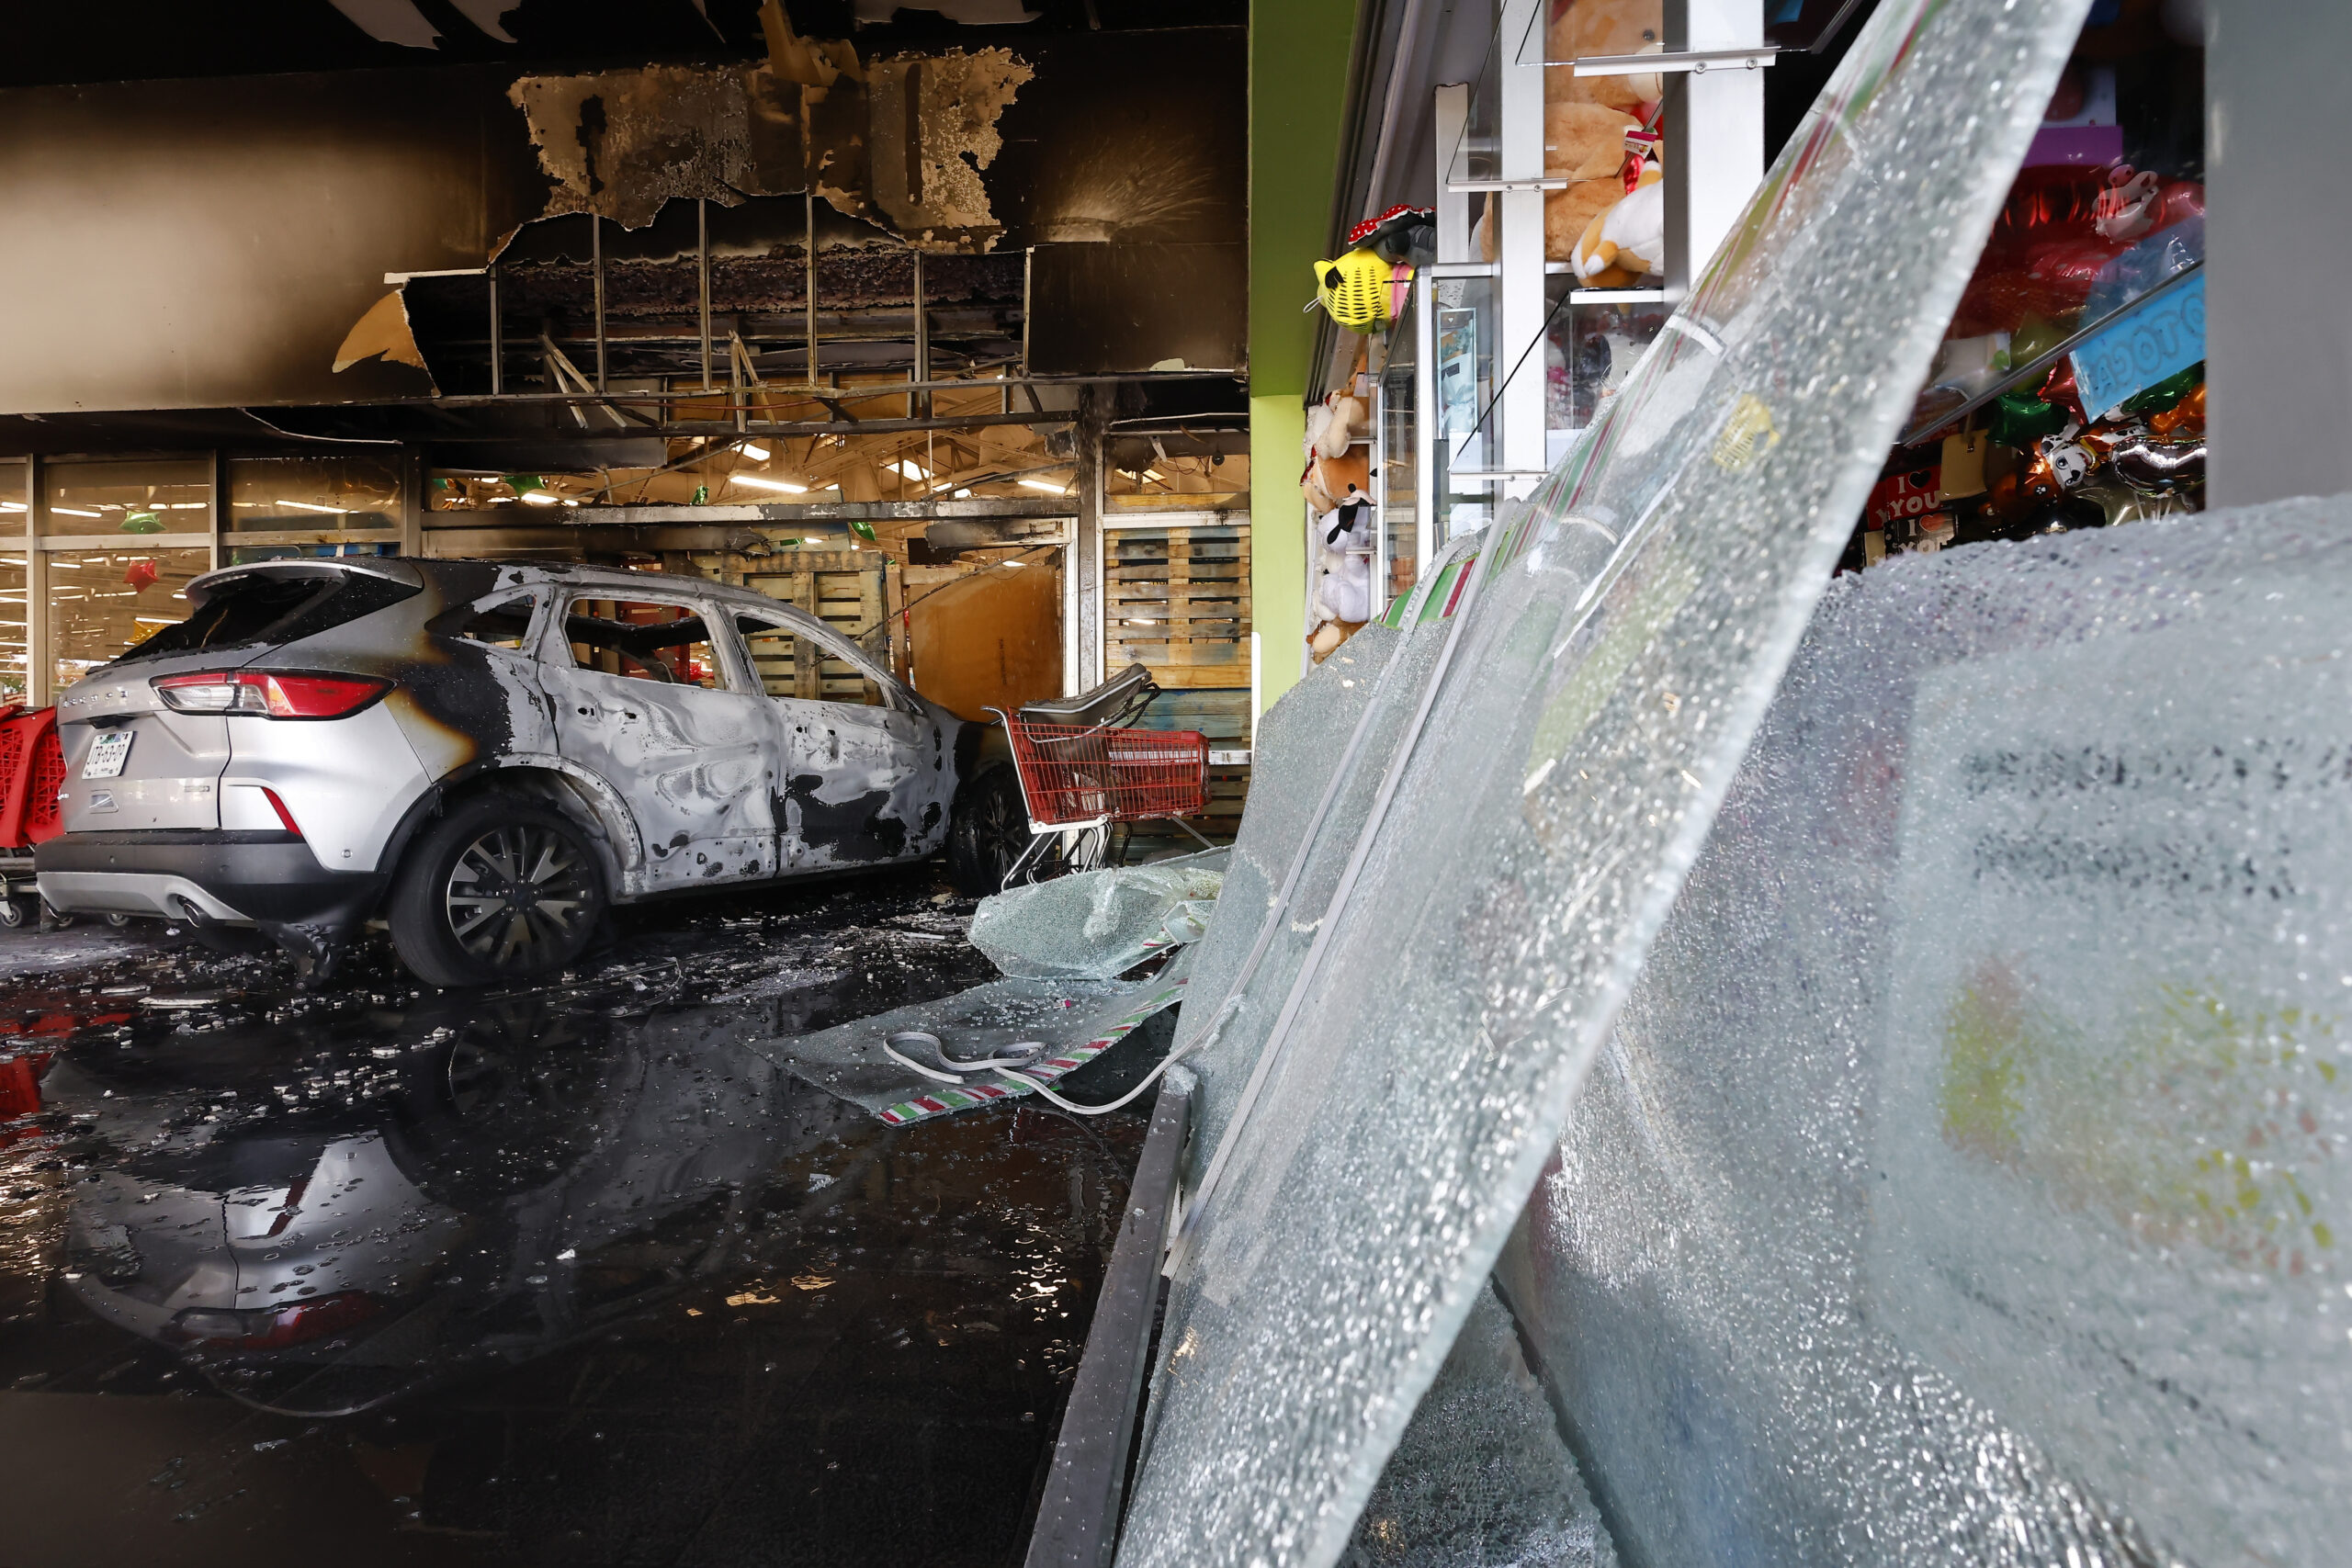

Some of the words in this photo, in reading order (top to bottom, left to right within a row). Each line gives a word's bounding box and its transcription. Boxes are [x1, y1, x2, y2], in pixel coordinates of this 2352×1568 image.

[1897, 476, 1906, 494] I
[1889, 490, 1941, 517] YOU
[1907, 519, 1917, 537] I
